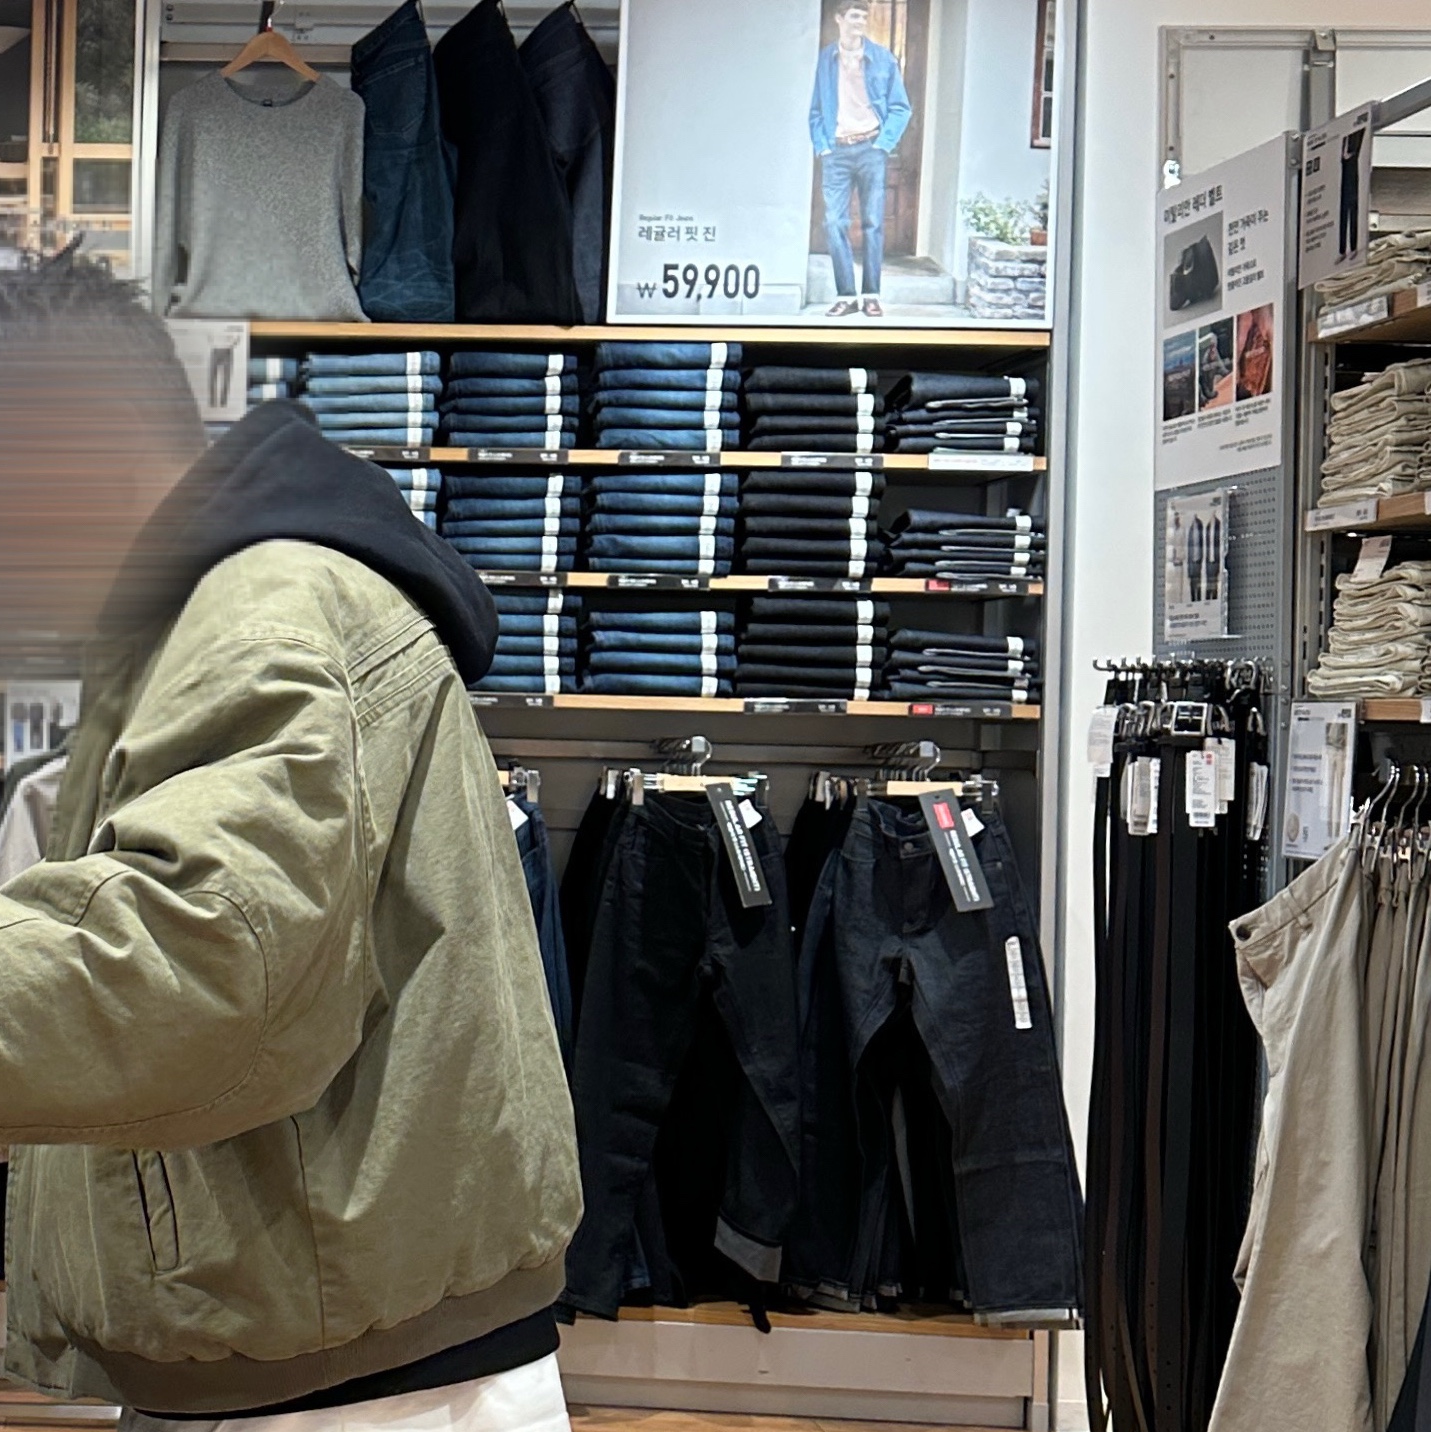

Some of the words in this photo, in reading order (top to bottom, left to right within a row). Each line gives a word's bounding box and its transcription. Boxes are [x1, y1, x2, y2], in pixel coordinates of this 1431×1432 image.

[638, 225, 680, 242] 레귤러
[685, 226, 698, 242] 핏
[702, 226, 716, 242] 진
